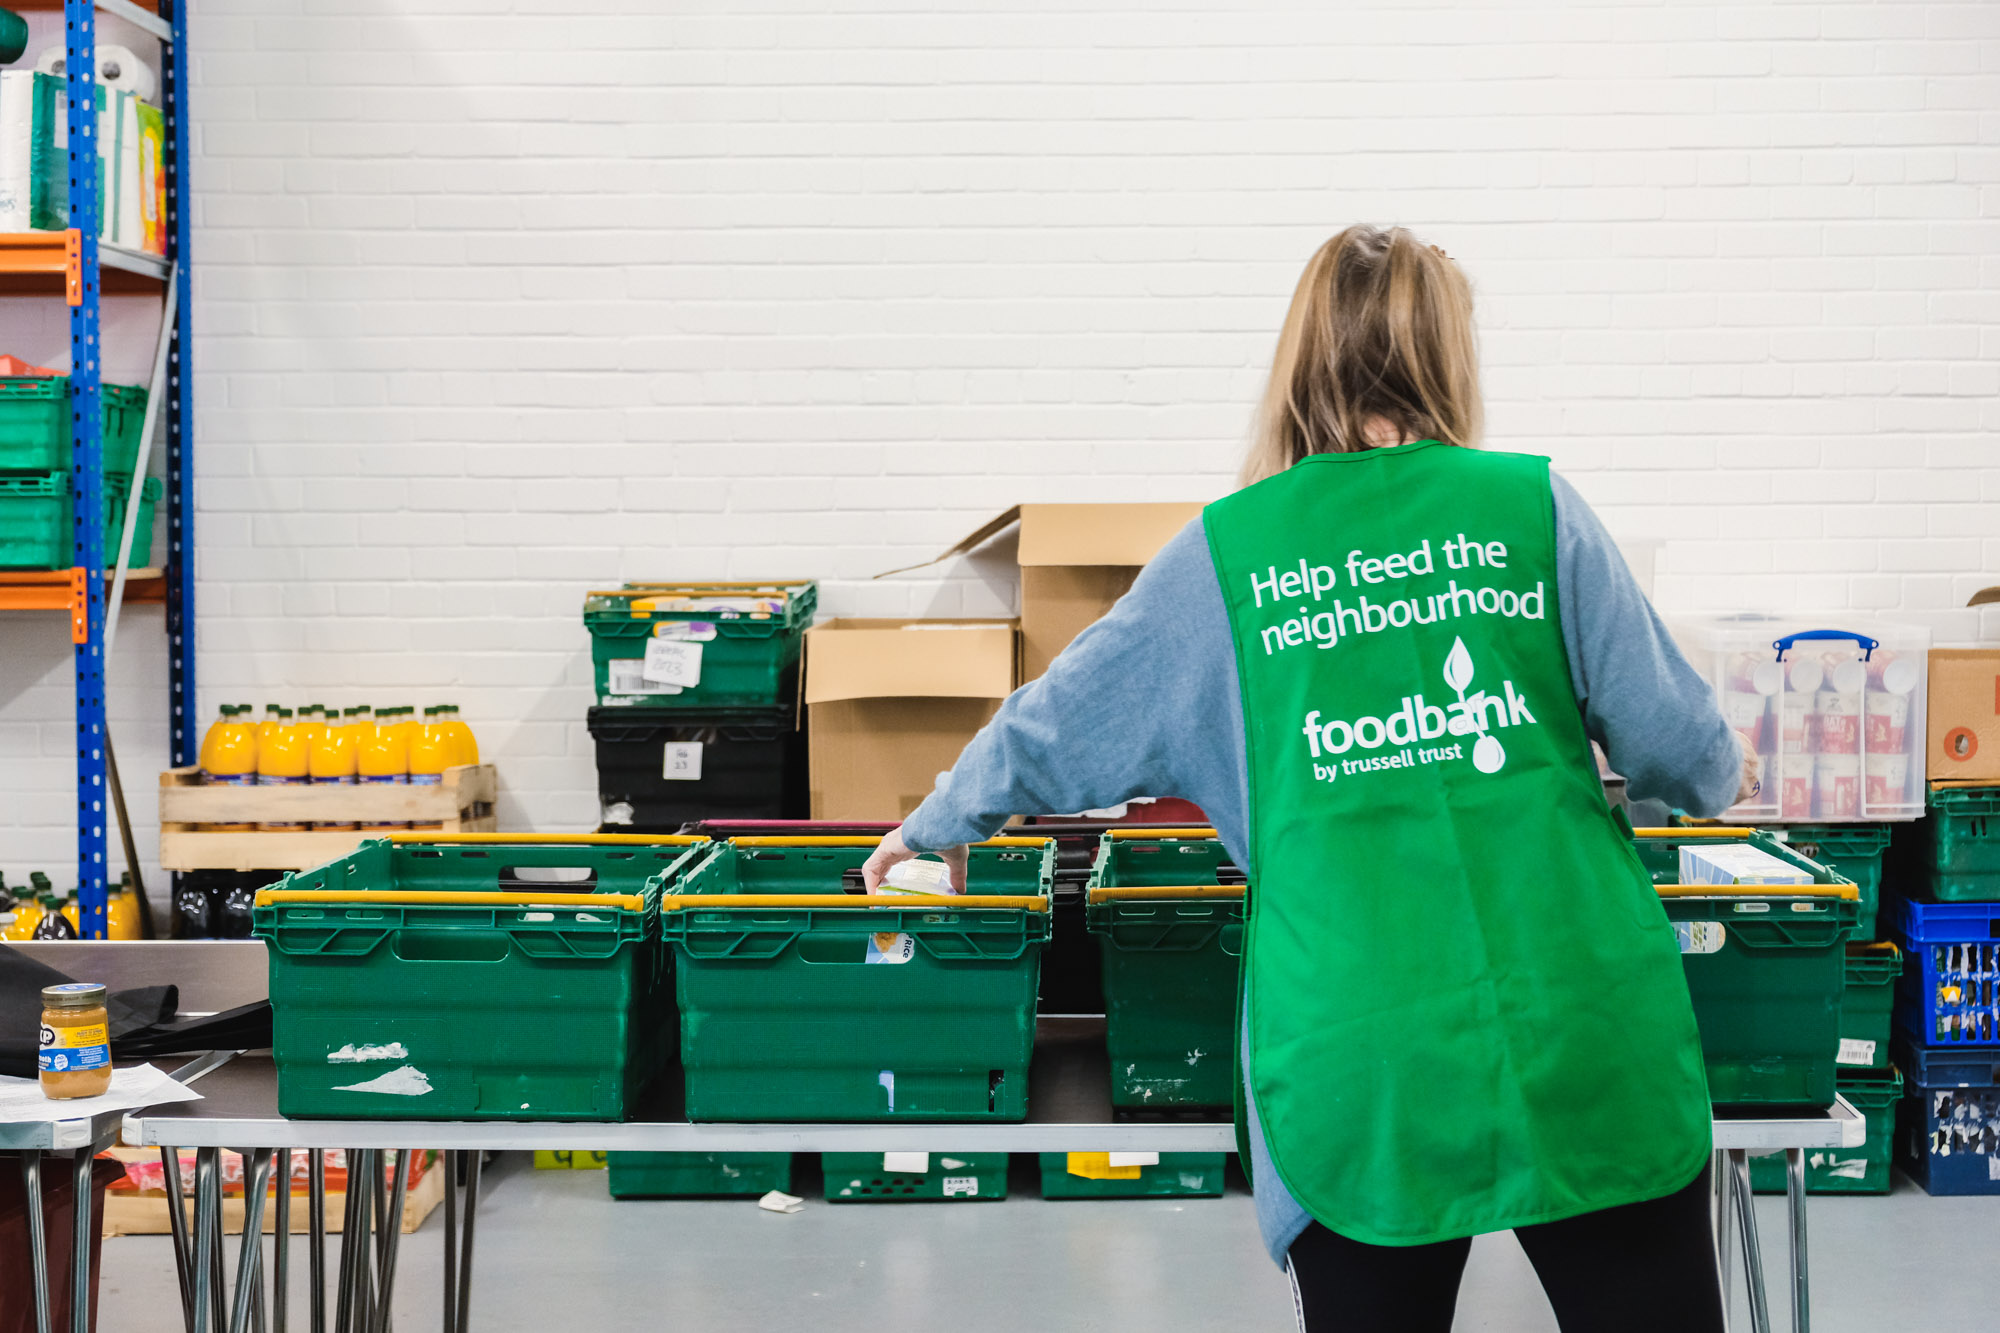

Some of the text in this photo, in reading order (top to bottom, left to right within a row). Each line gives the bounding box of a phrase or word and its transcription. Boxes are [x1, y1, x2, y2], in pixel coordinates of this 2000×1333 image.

[1250, 533, 1508, 608] Help feed the
[1260, 580, 1545, 655] neighbourhood
[1302, 680, 1537, 758] foodbank
[1313, 743, 1463, 783] by trussell trust
[902, 939, 913, 958] Rice
